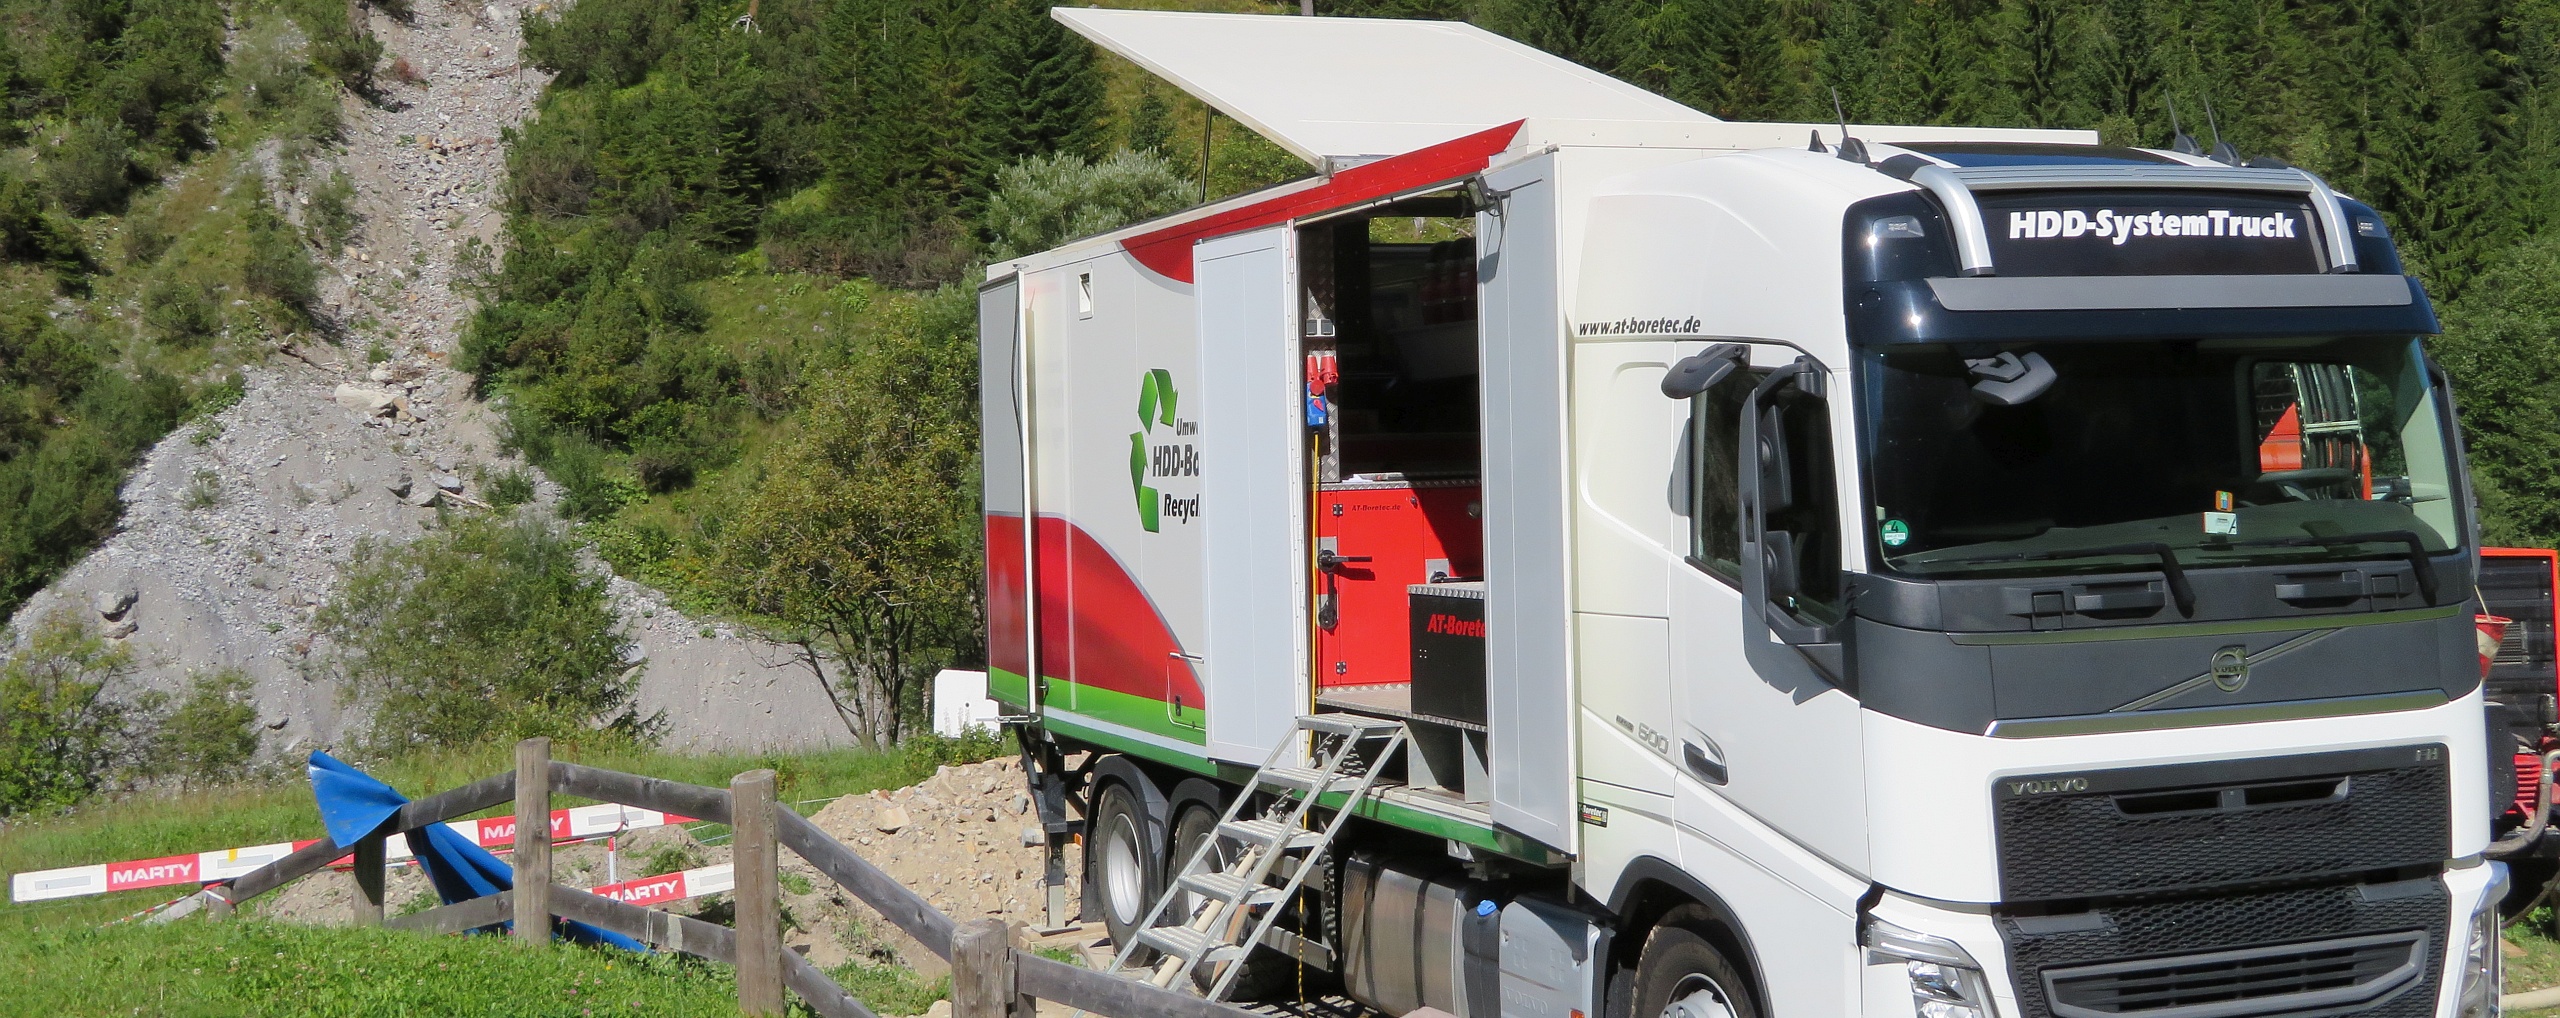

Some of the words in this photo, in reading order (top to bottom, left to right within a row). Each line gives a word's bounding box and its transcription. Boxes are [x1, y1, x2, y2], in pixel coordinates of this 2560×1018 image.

[2009, 209, 2295, 245] HDD-SystemTruck
[1579, 315, 1701, 336] www.at-boretec.de
[1164, 493, 1201, 525] Recycl
[2007, 777, 2089, 796] VOLVO
[483, 816, 564, 840] MAY
[112, 863, 194, 885] MARTY
